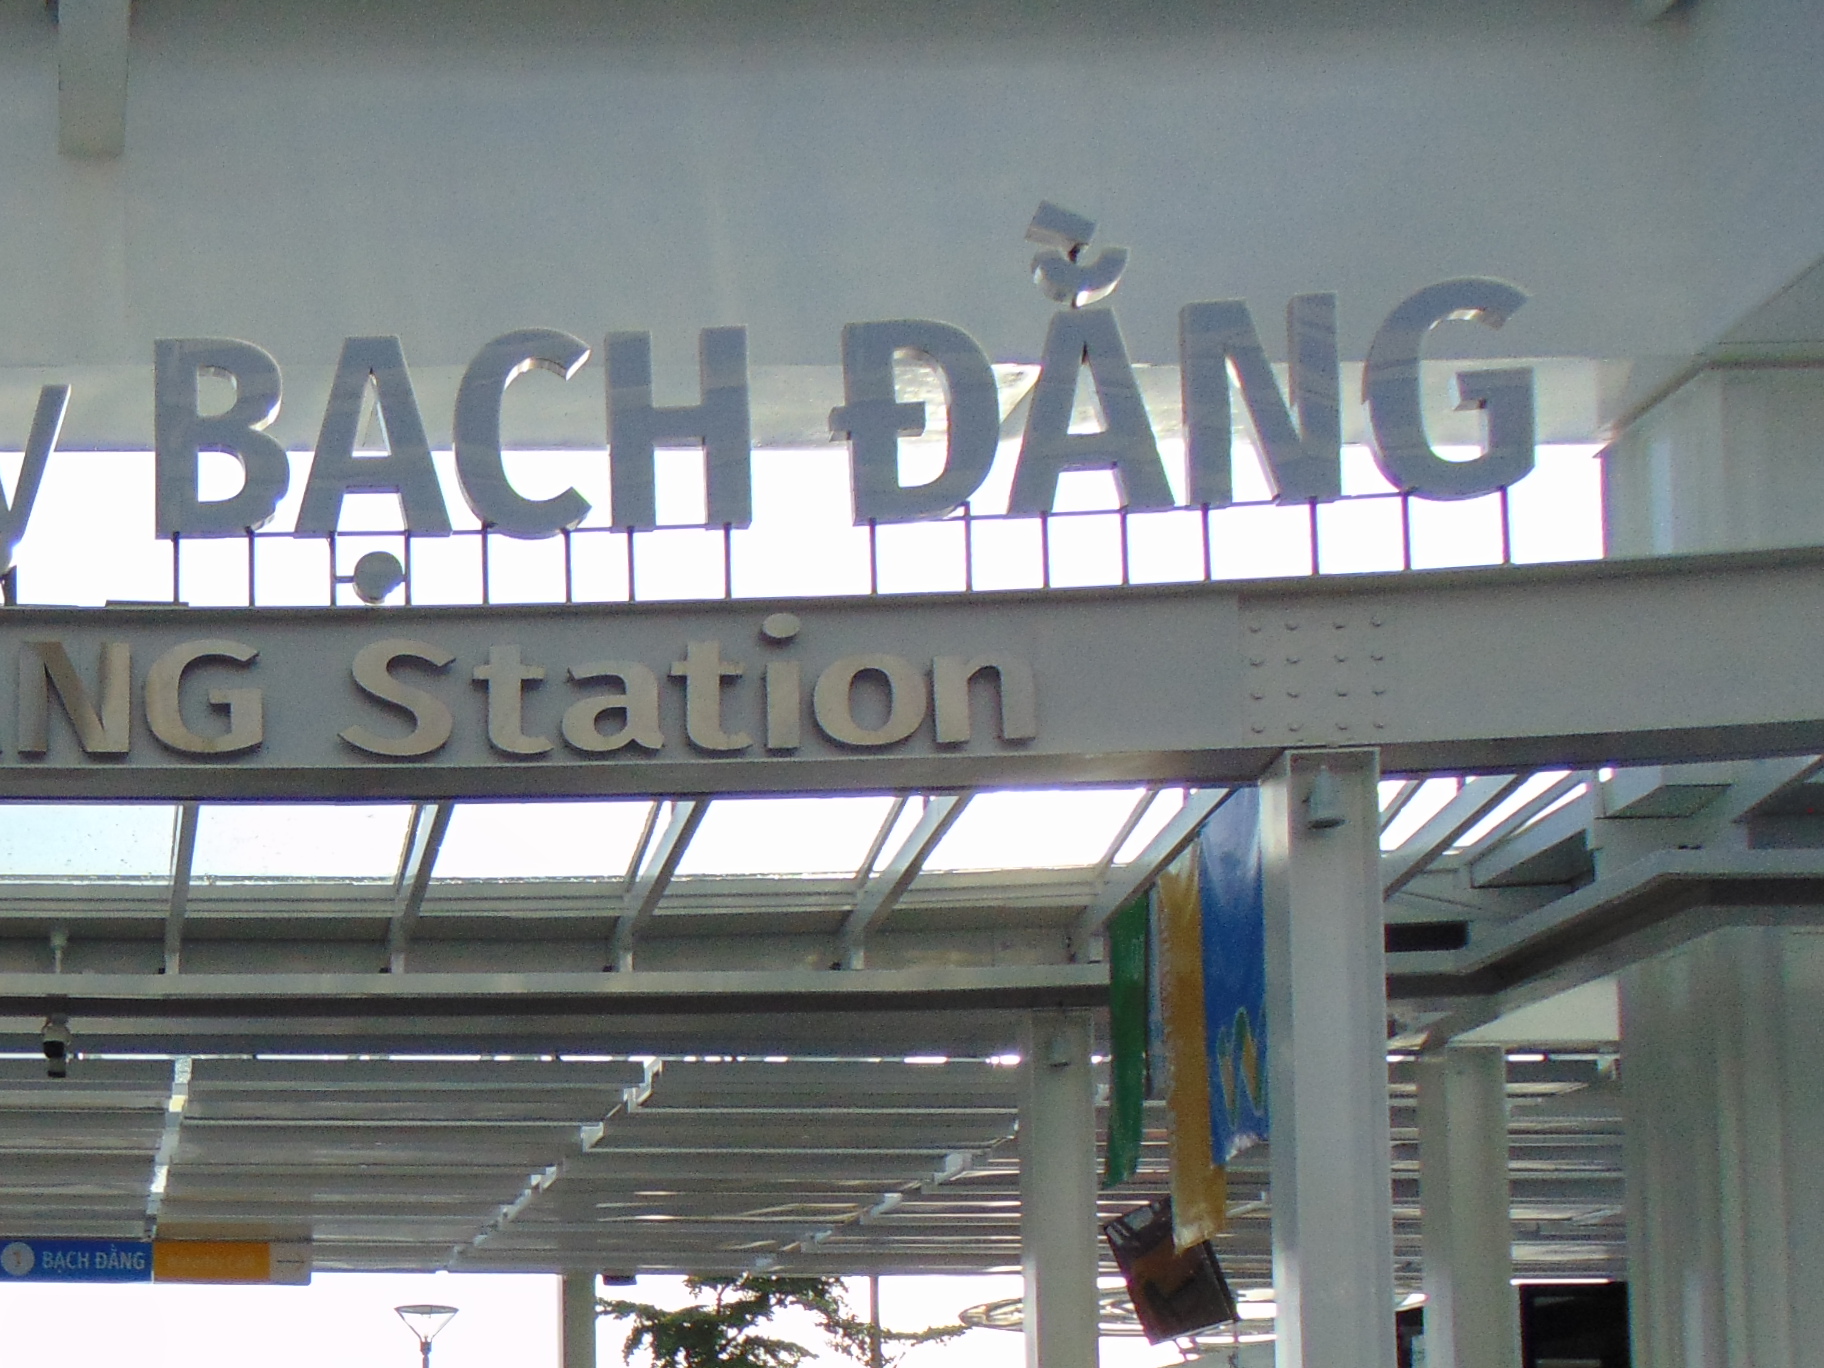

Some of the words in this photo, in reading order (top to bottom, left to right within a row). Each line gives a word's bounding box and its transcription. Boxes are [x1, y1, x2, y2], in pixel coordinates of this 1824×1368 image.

[152, 326, 753, 606] BẠCH
[828, 200, 1536, 524] ĐẰNG
[338, 612, 1037, 758] Station
